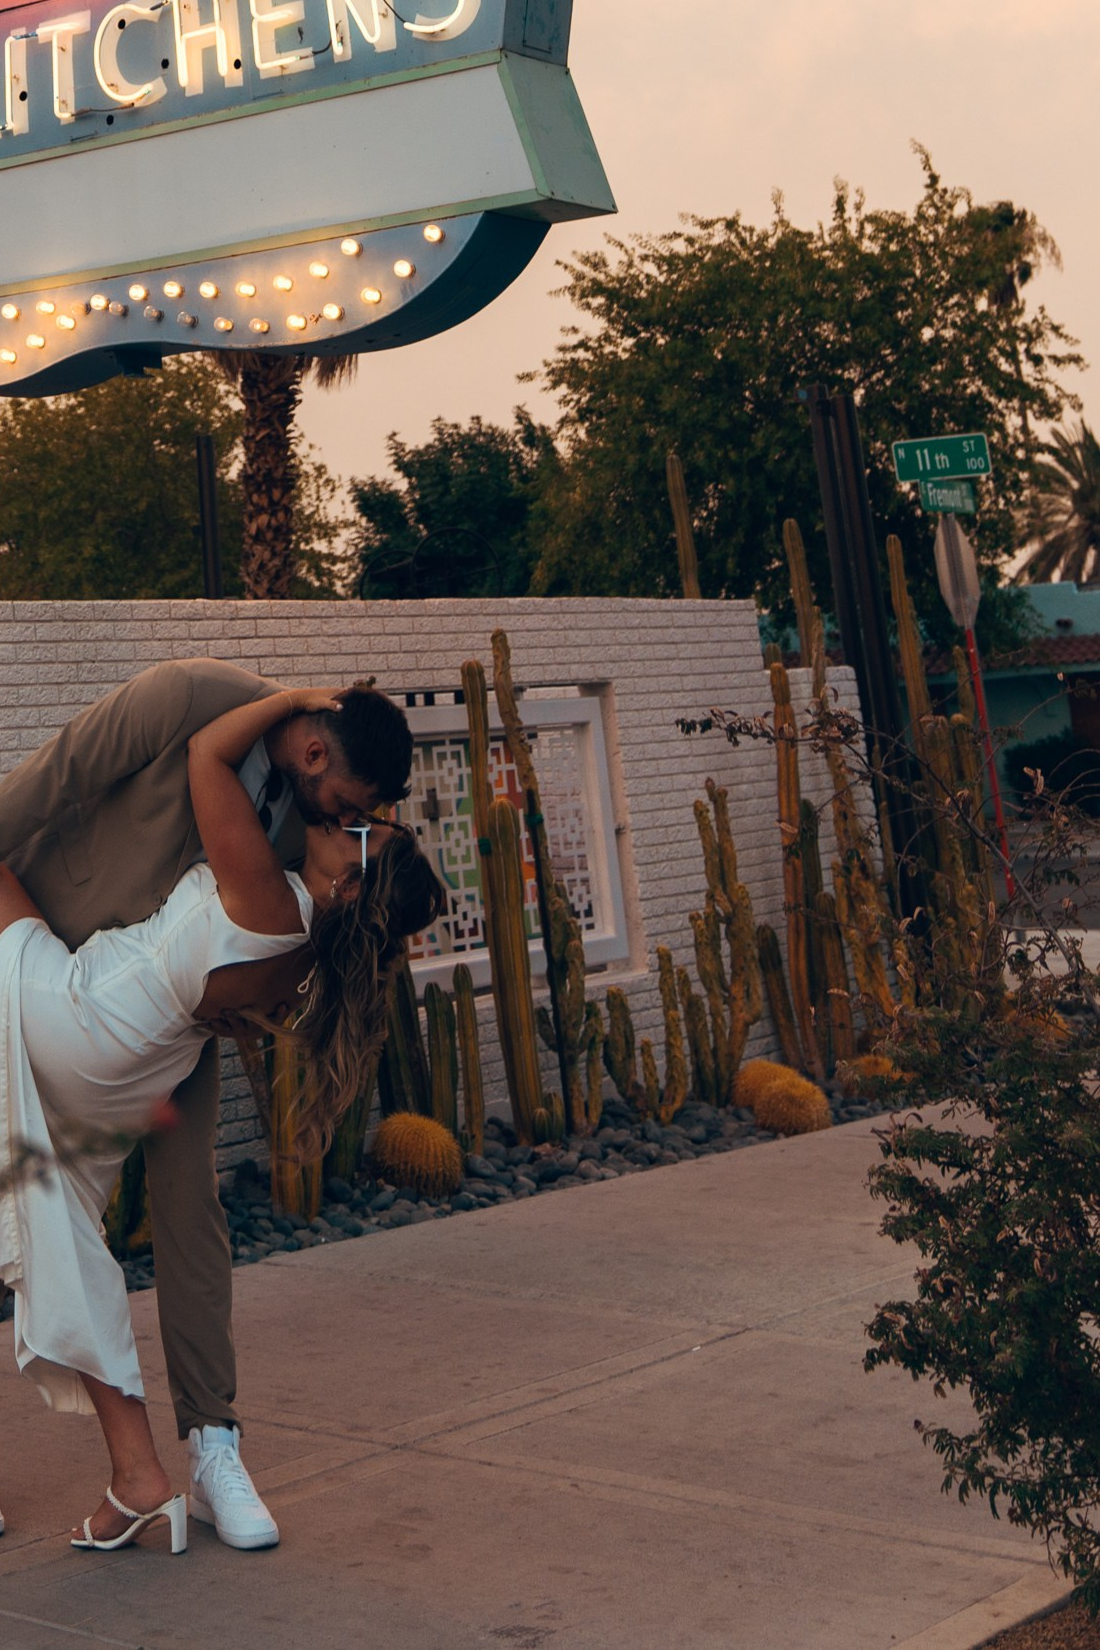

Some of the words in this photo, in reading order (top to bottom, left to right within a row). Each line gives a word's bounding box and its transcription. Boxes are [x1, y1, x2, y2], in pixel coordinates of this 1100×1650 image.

[897, 447, 906, 460] N
[962, 439, 976, 453] ST
[965, 457, 985, 471] 100
